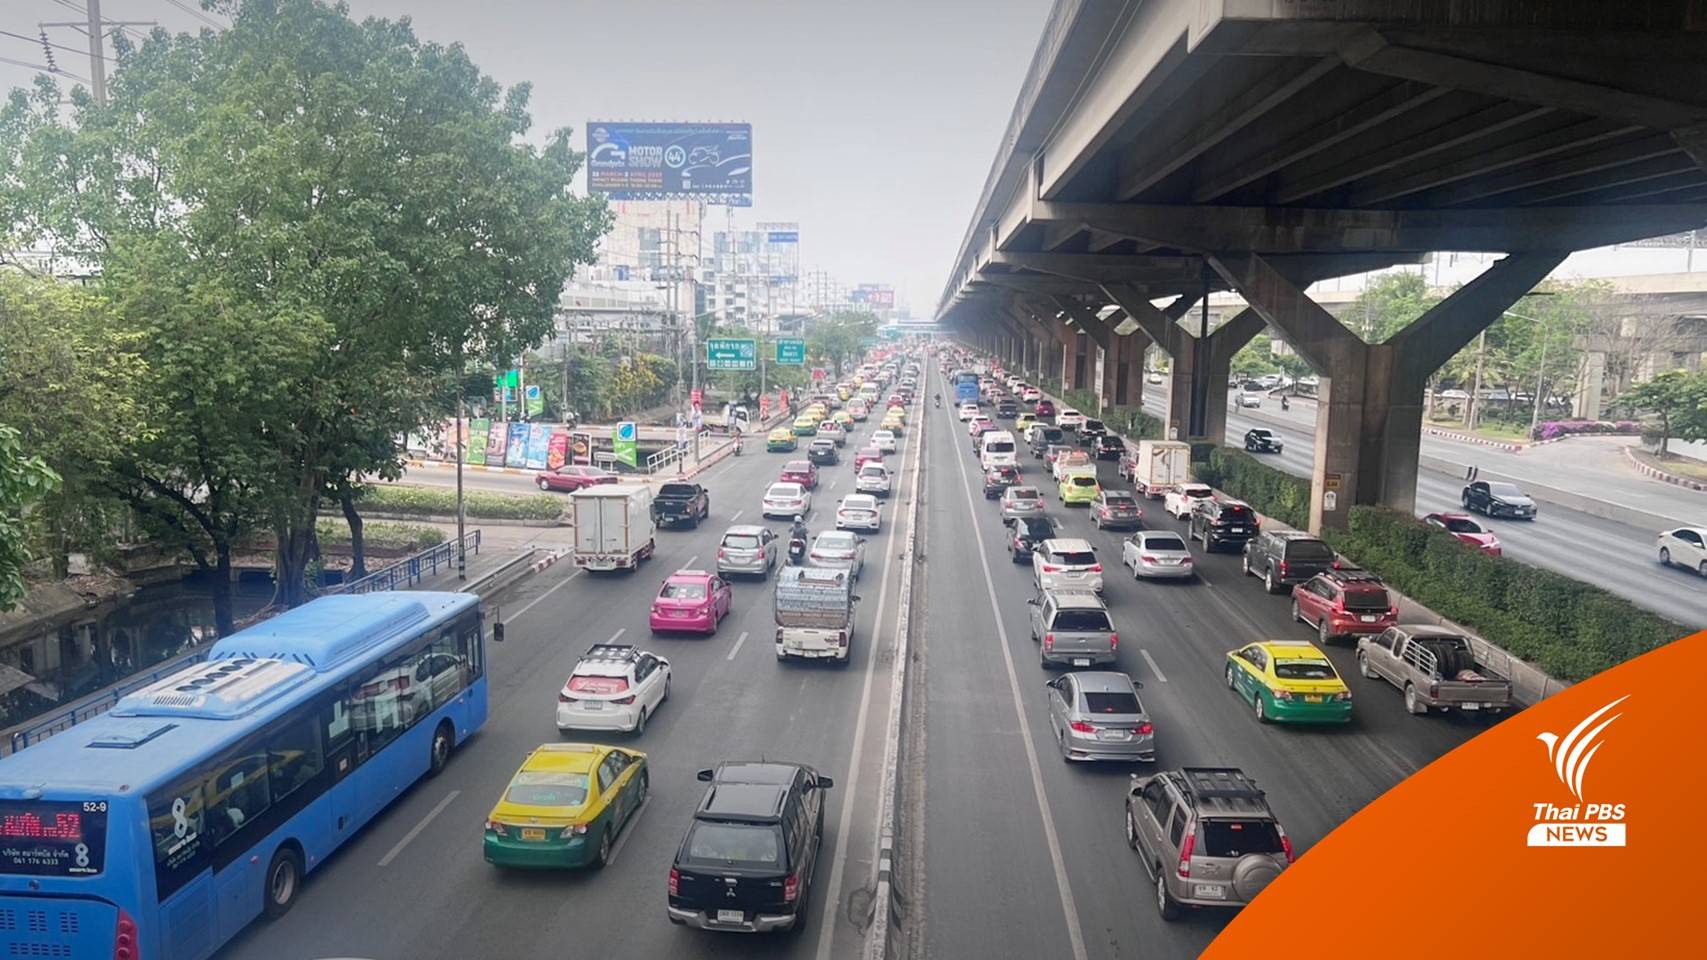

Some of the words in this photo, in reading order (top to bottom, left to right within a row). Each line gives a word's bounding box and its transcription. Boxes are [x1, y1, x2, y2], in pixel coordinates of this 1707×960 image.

[628, 145, 663, 155] MOTOR
[628, 156, 663, 168] SHOW
[83, 802, 107, 812] 52-9
[56, 813, 81, 838] 52
